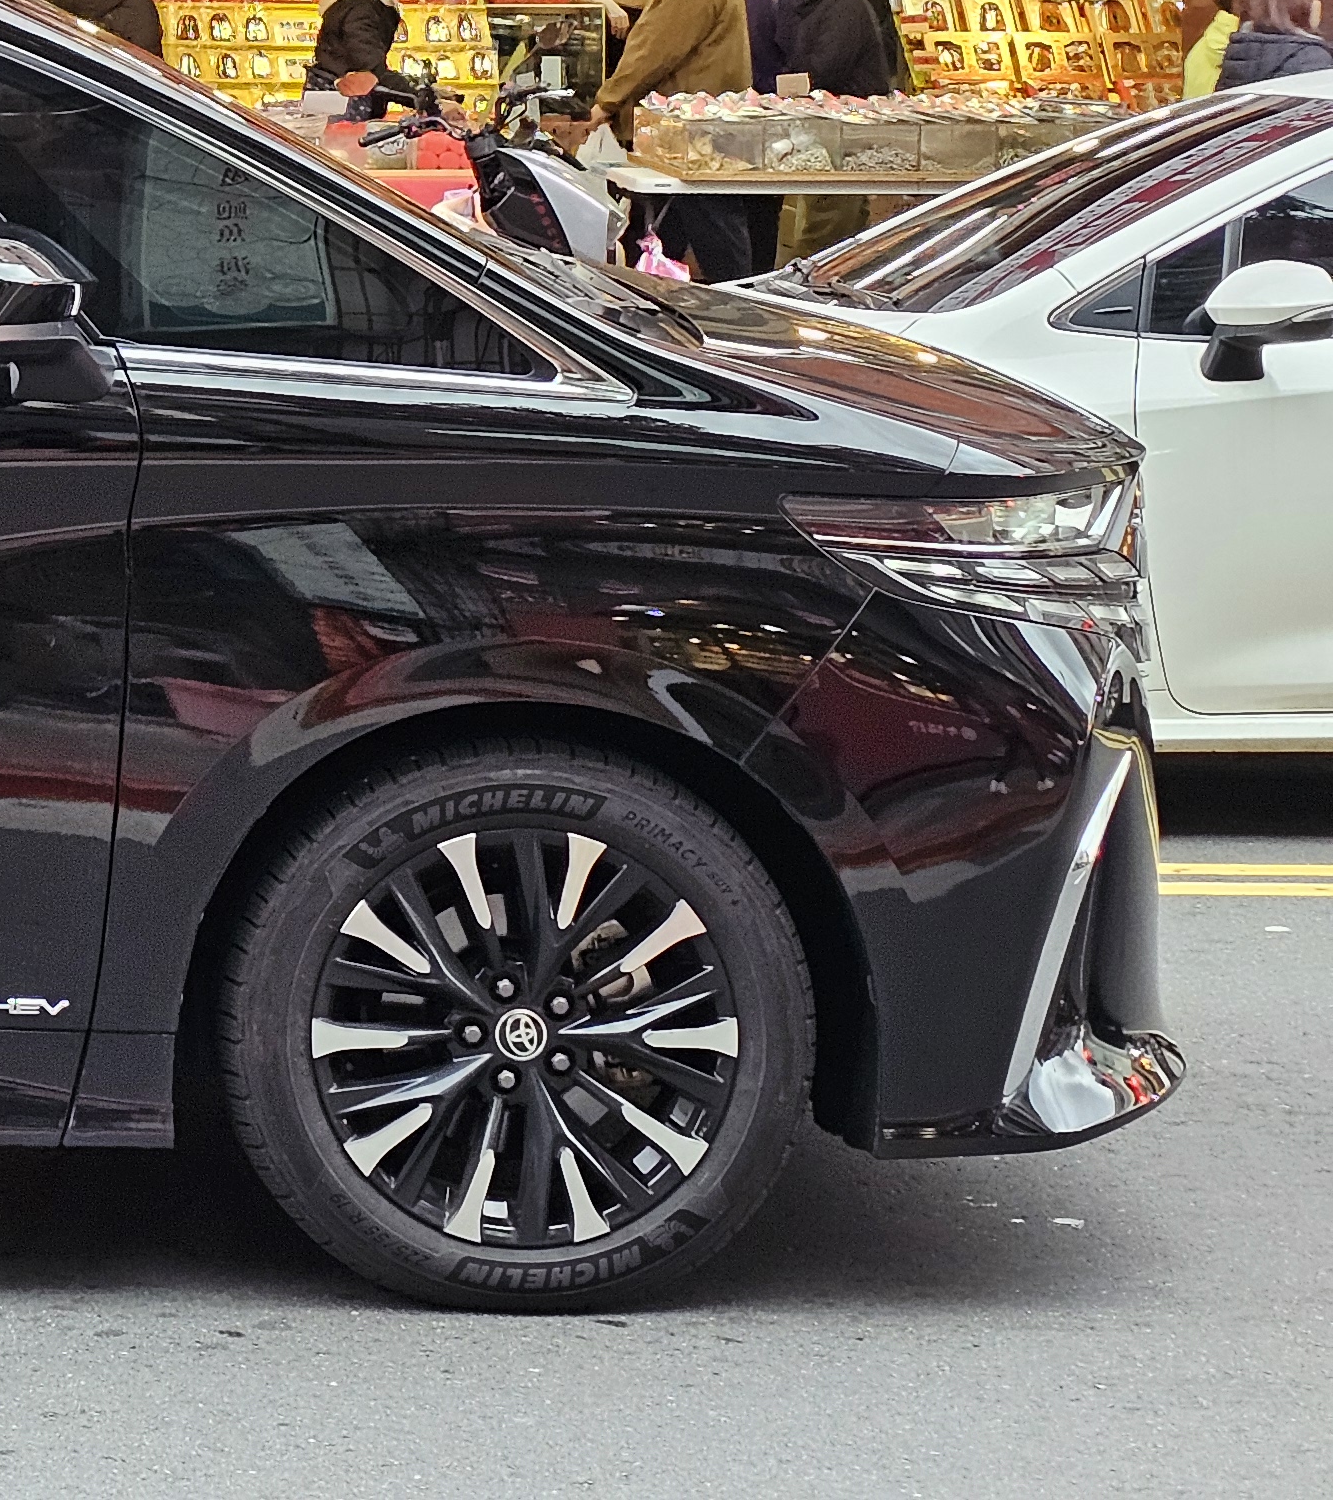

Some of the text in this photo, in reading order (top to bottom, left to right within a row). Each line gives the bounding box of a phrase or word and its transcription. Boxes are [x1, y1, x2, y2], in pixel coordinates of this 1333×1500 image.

[410, 787, 596, 835] MICHELIN
[621, 810, 708, 869] PRIMACY
[456, 1246, 644, 1287] MICHELIN
